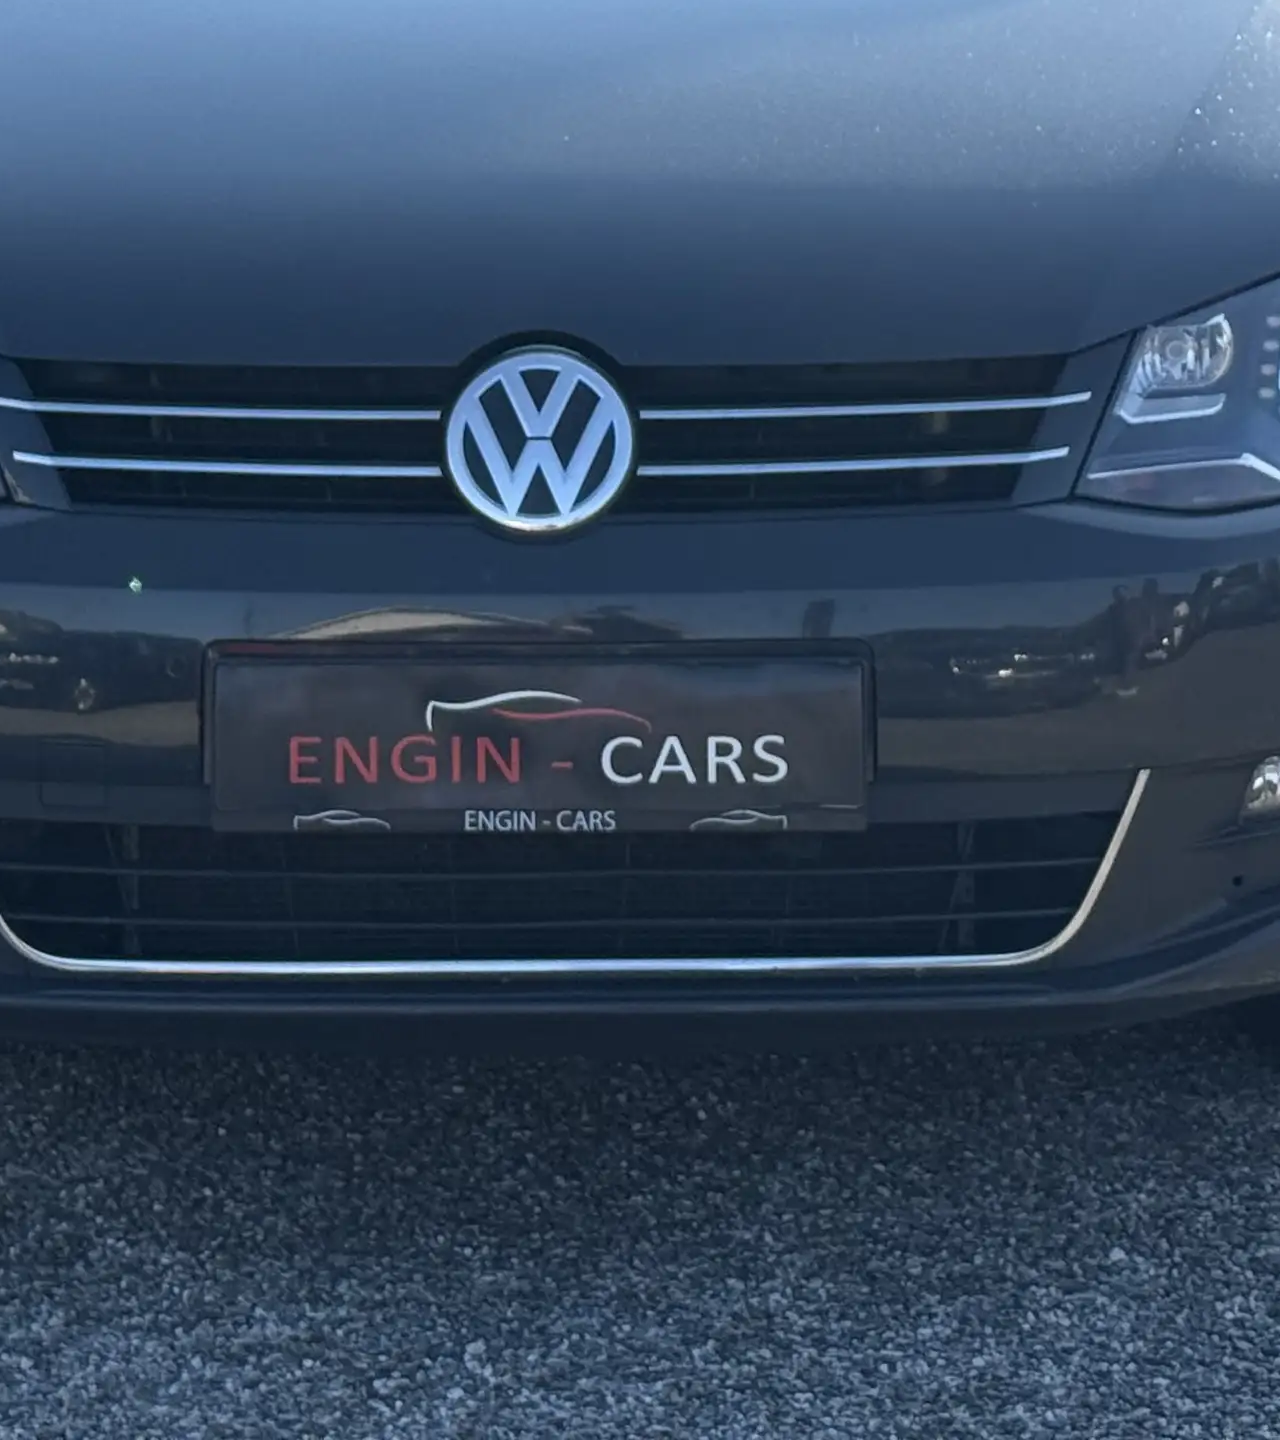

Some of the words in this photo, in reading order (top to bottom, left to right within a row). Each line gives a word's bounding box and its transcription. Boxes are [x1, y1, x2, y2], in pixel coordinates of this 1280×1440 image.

[289, 735, 520, 784] ENGIN
[601, 734, 789, 785] CARS
[464, 809, 536, 832] ENGIN
[556, 809, 616, 832] CARS
